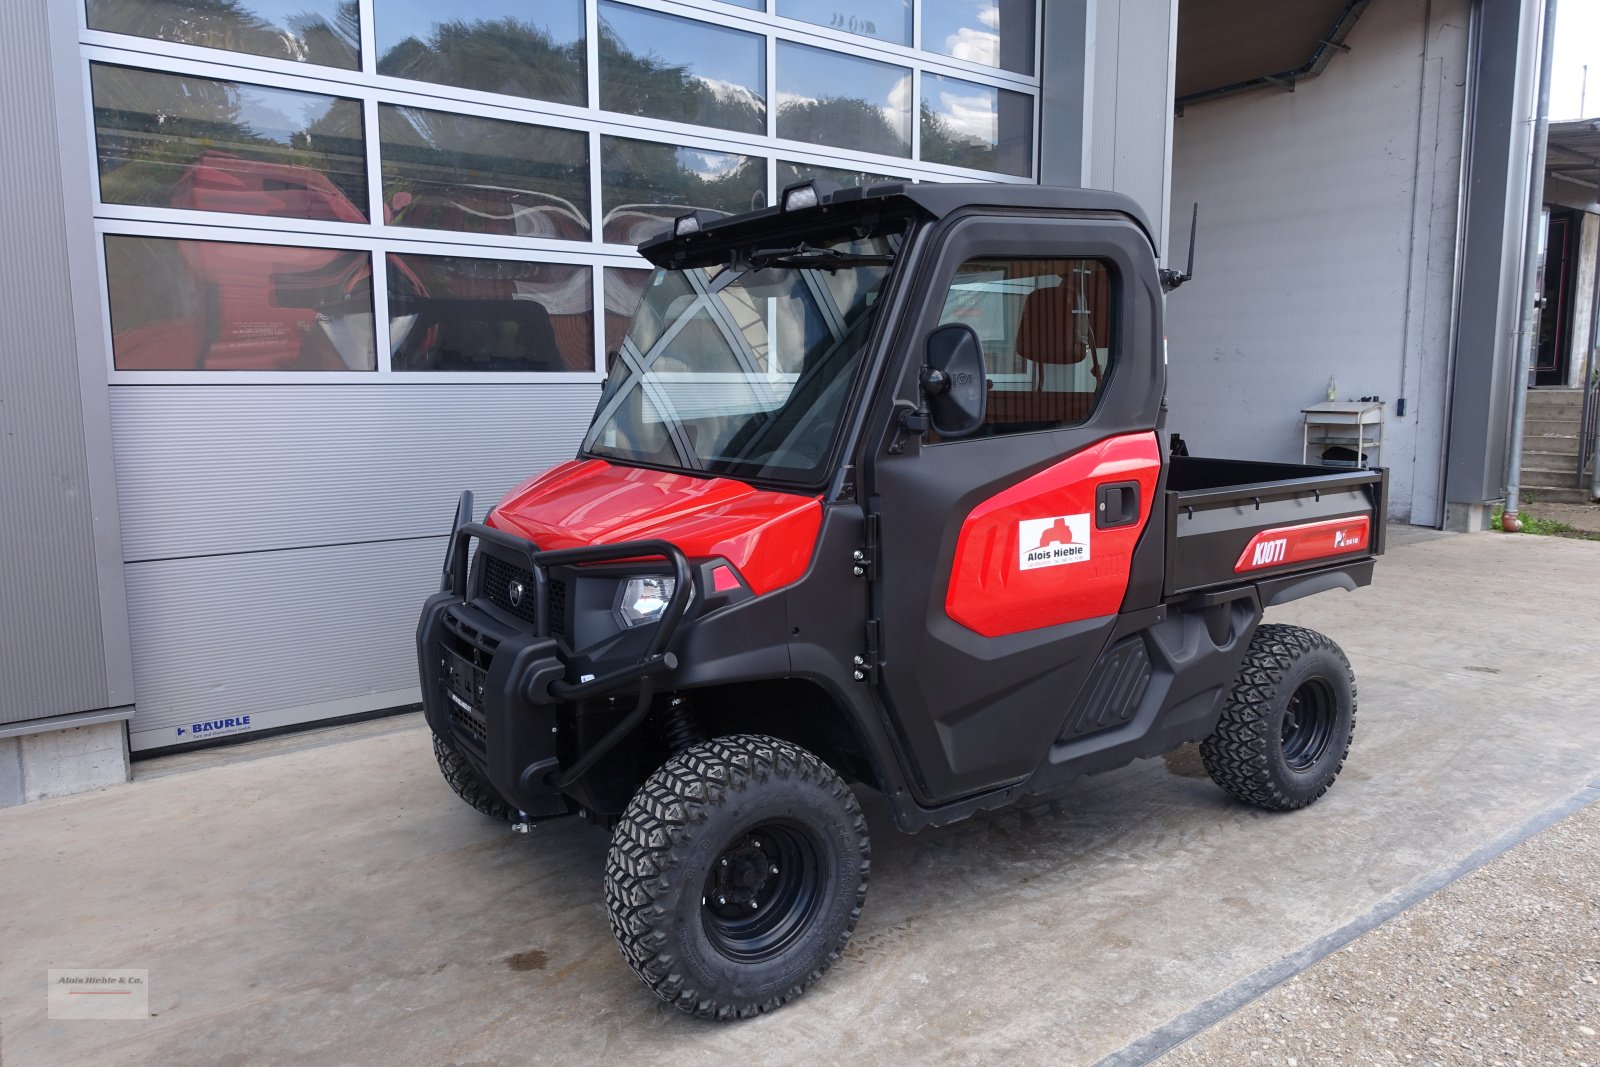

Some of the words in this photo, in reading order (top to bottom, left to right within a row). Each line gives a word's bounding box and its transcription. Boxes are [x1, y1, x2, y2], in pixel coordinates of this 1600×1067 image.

[1027, 551, 1051, 562] Alois
[1053, 546, 1083, 557] Hieble
[1252, 539, 1287, 565] KIOTI
